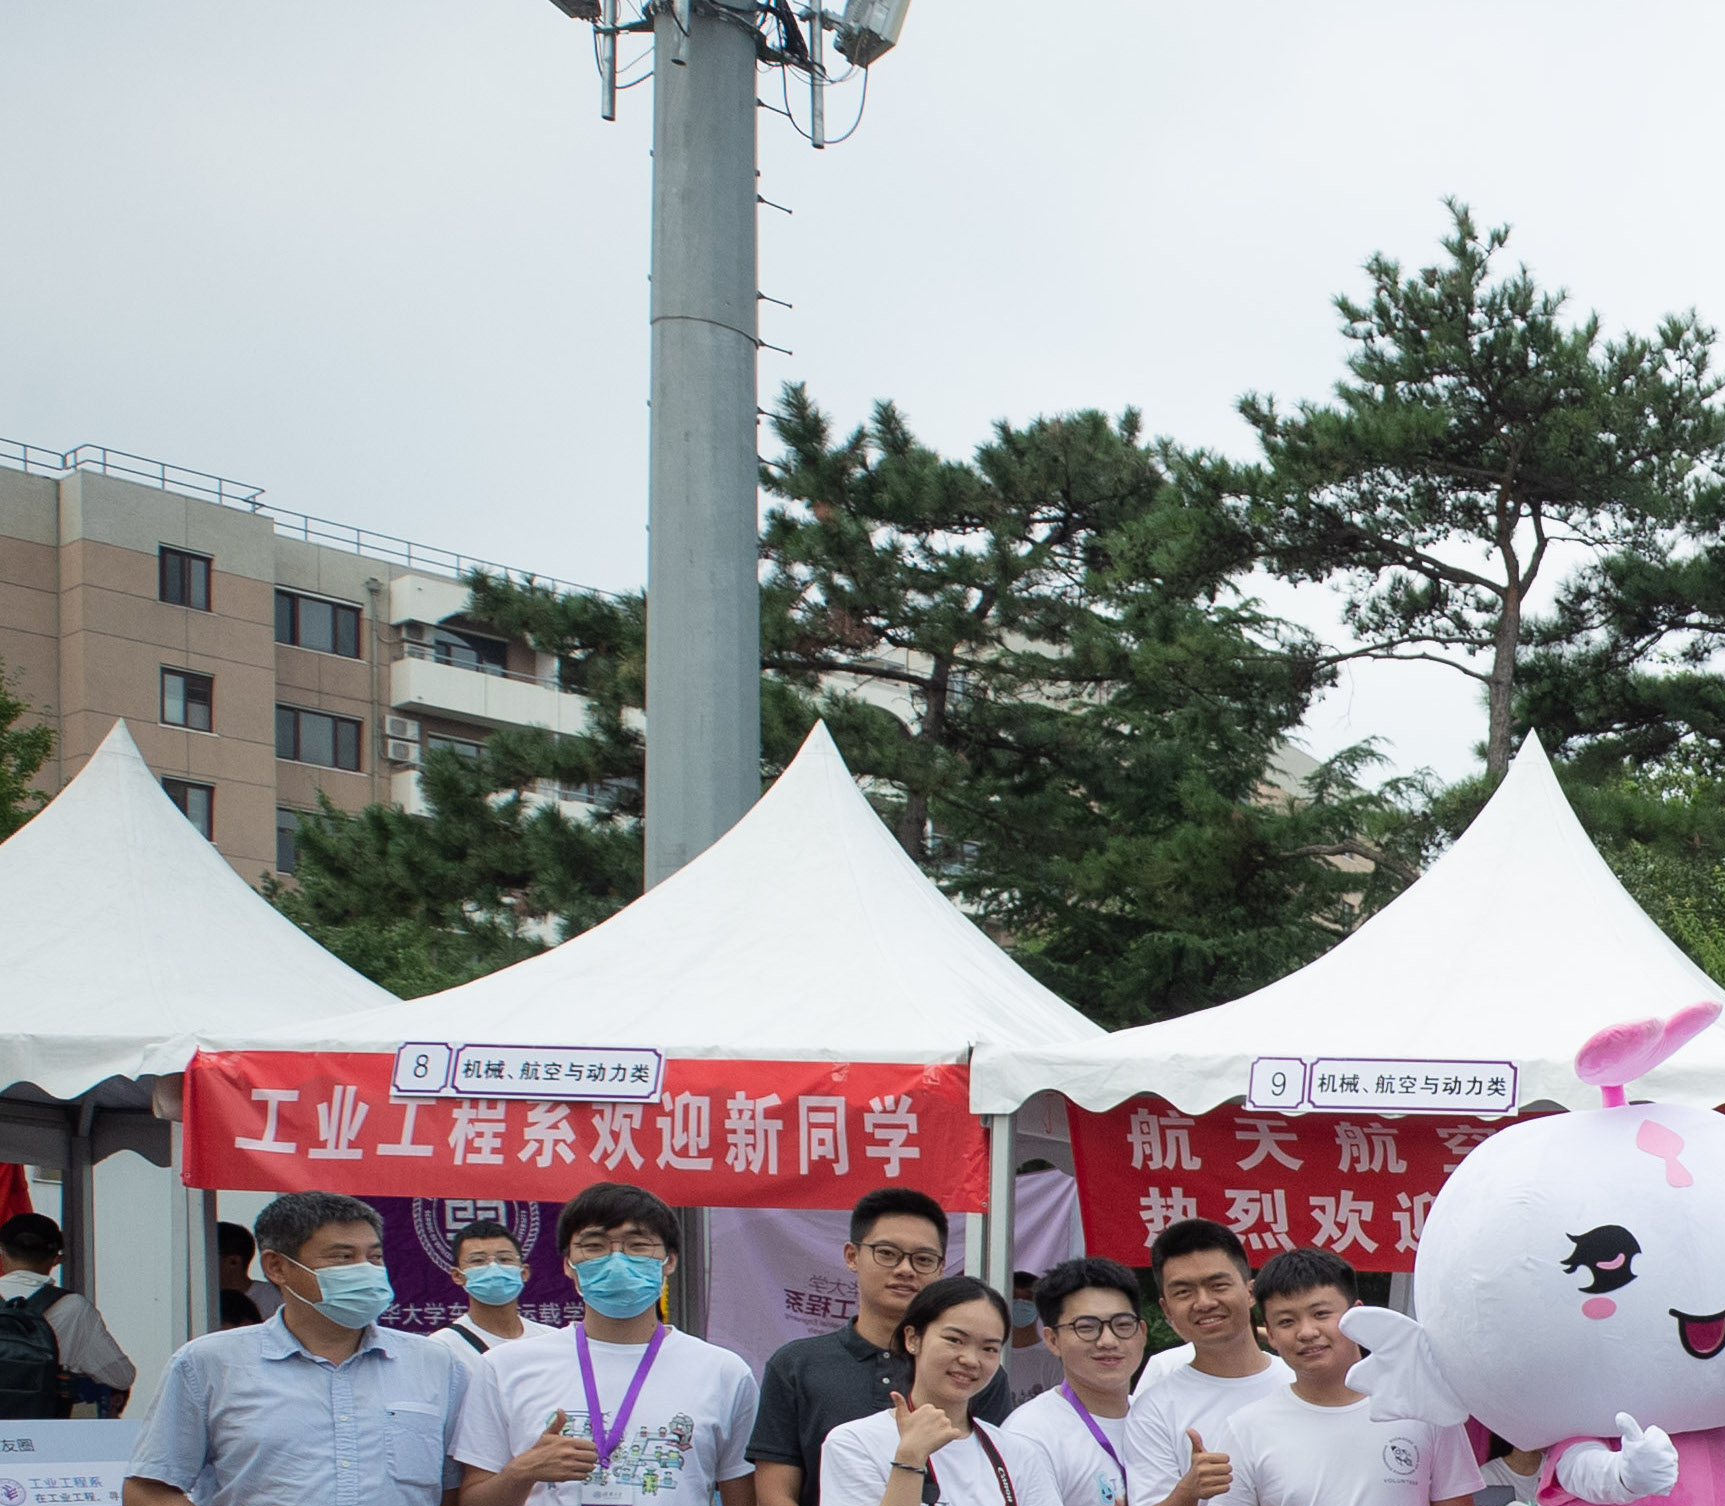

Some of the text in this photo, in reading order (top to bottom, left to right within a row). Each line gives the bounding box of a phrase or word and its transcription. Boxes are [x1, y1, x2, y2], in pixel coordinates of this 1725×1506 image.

[412, 1054, 430, 1079] 8
[462, 1058, 651, 1085] 机械、航空与动力类
[1270, 1072, 1287, 1097] 9
[1317, 1073, 1507, 1098] 机械、航空与动力类
[234, 1085, 922, 1177] 工业工程系欢迎新同学
[29, 1476, 103, 1489] 工业工程系
